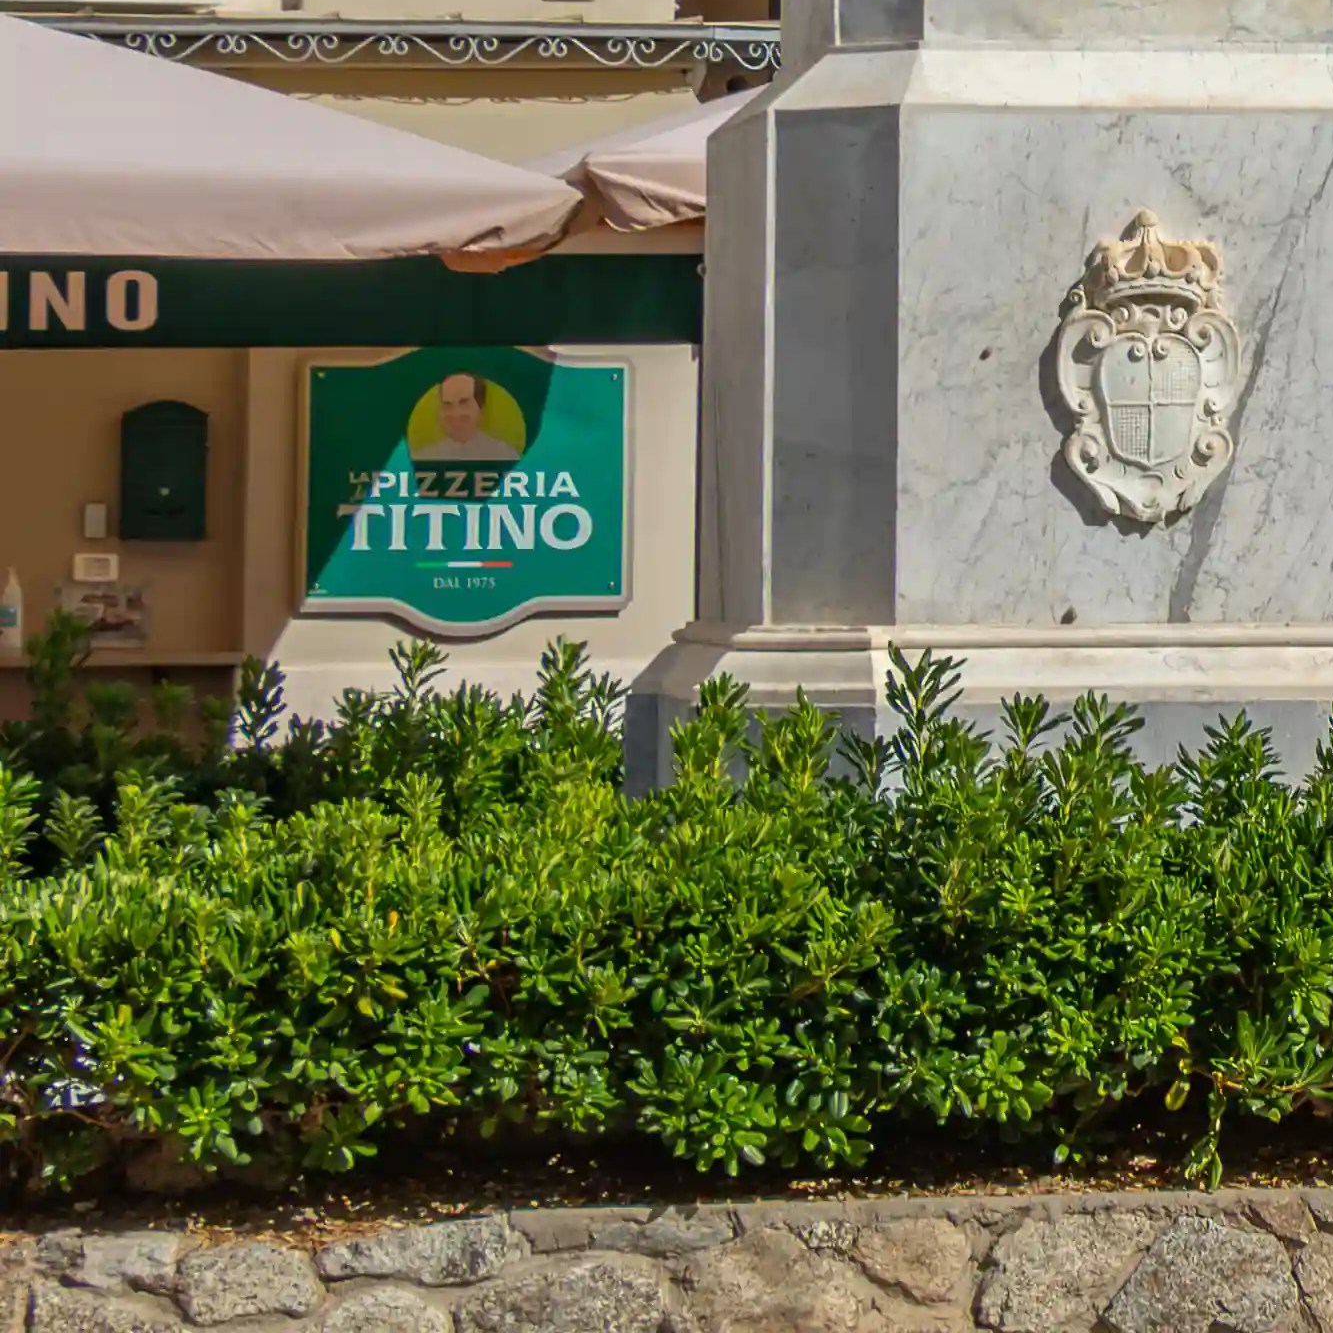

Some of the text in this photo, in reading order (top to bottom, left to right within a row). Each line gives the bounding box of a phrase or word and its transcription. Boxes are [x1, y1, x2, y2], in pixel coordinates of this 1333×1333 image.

[370, 470, 581, 498] PIZZERIA
[336, 503, 593, 551] TITINO
[433, 576, 461, 590] DAL
